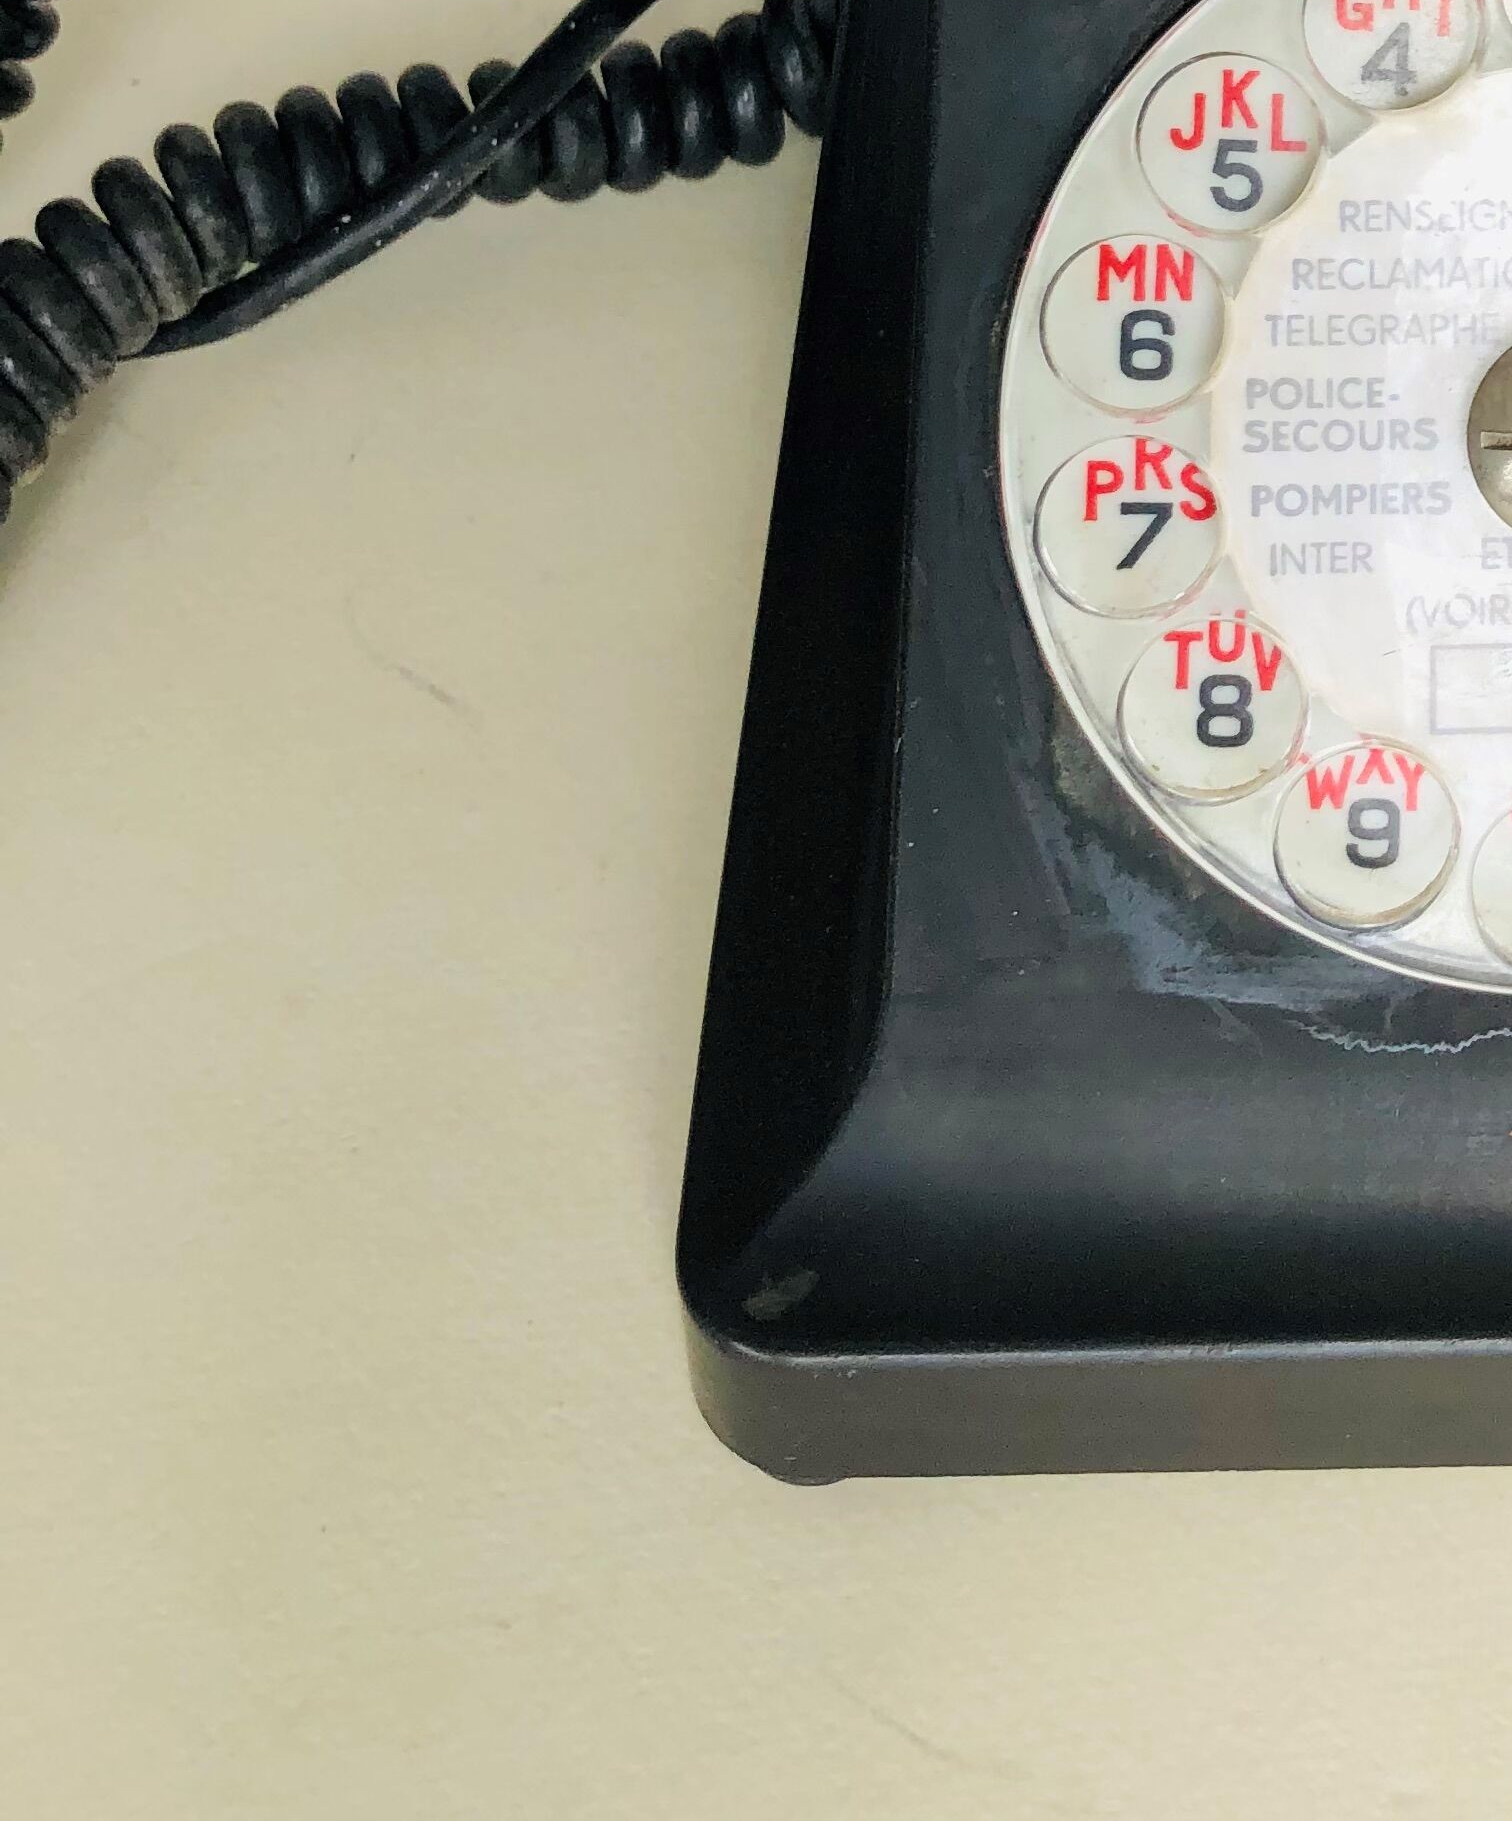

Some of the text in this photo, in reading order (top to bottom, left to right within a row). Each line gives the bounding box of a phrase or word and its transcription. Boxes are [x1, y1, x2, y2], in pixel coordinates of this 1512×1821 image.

[1360, 22, 1418, 97] 4
[1169, 68, 1308, 152] JKL
[1209, 138, 1263, 212] 5
[1096, 243, 1195, 302] MN
[1119, 308, 1175, 381] 6
[1264, 312, 1501, 347] TELEGRAPHE
[1245, 376, 1400, 411] POLICE-
[1241, 416, 1440, 454] SECOURS
[1083, 437, 1218, 522] PRS
[1250, 480, 1453, 518] POMPIERS
[1116, 502, 1174, 570] 7
[1269, 540, 1375, 576] INTER
[1163, 609, 1283, 692] TUV
[1196, 673, 1254, 748] 8
[1346, 797, 1401, 870] 9
